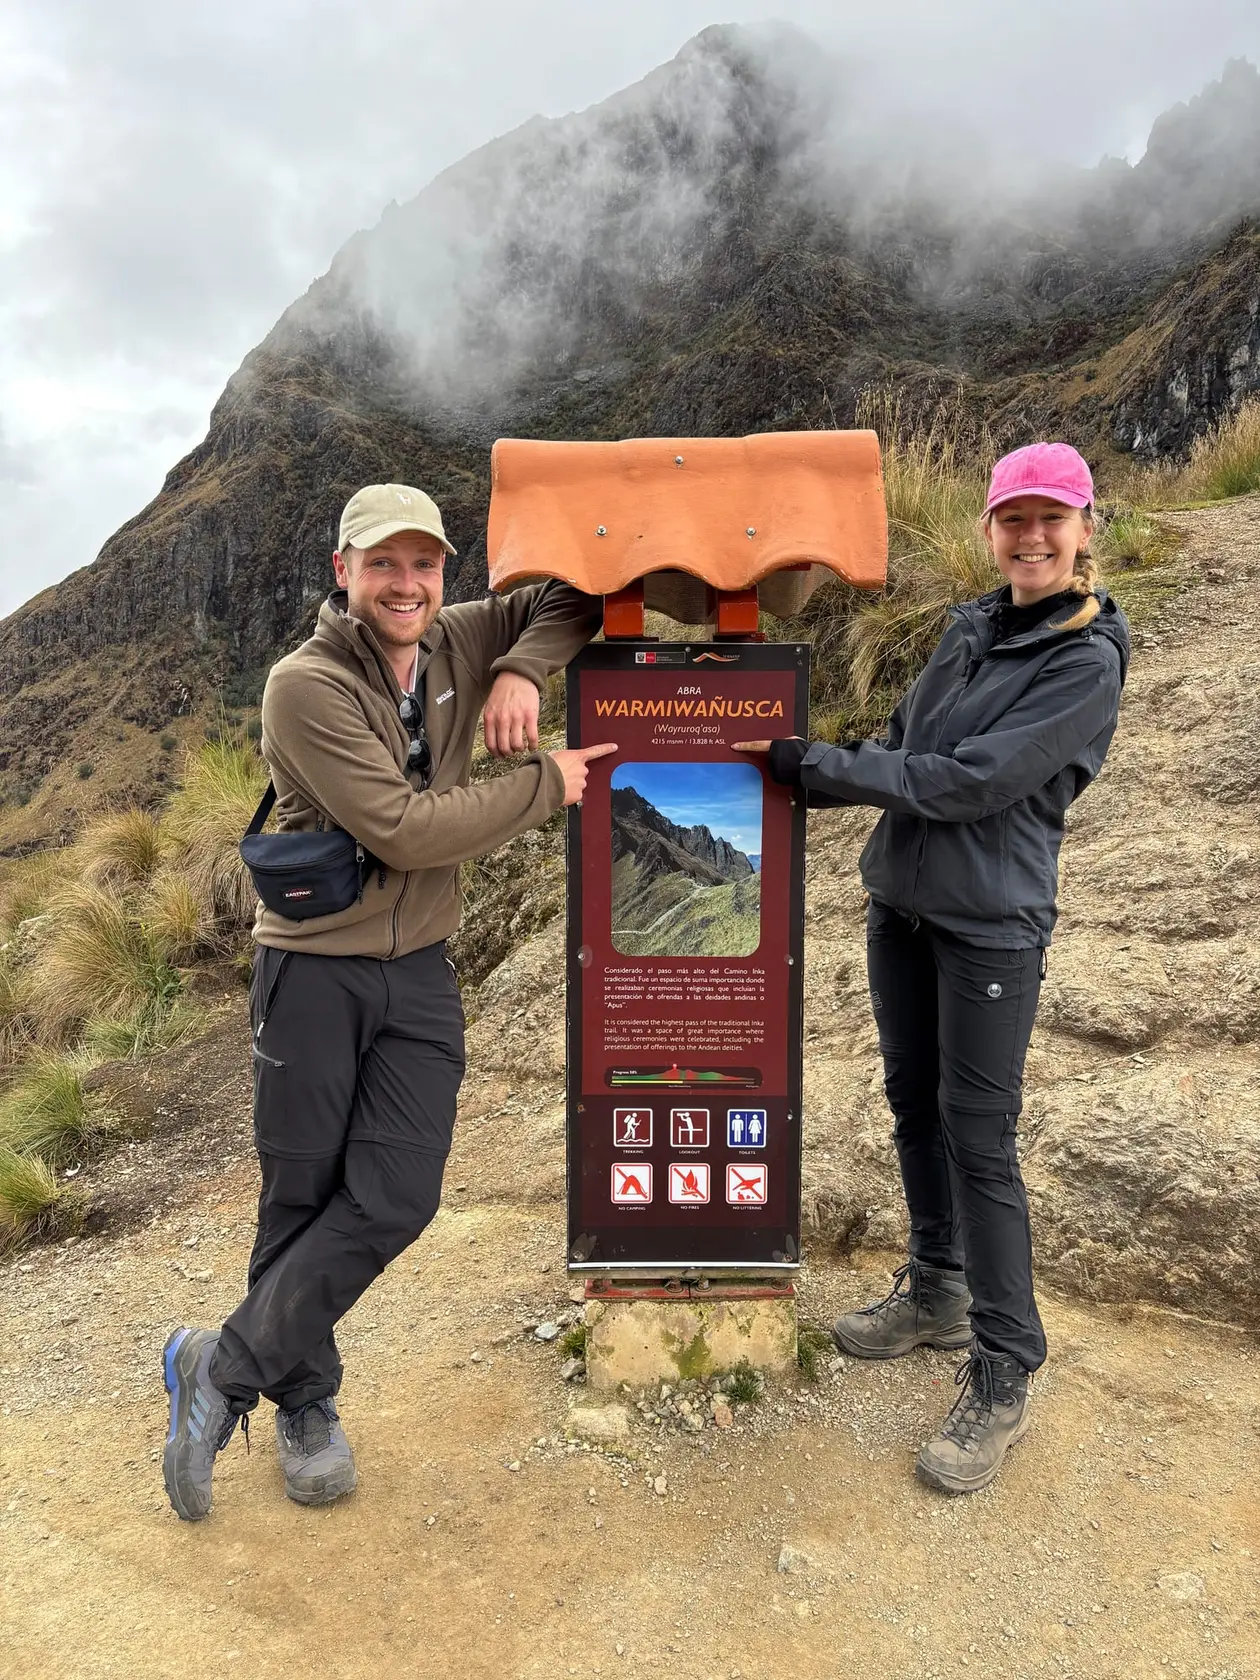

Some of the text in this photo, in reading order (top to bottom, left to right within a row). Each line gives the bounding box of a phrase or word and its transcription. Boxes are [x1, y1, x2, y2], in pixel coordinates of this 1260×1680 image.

[677, 686, 702, 695] ABRA
[595, 696, 784, 717] WARMIWAÑUSCA
[708, 976, 744, 984] importancia
